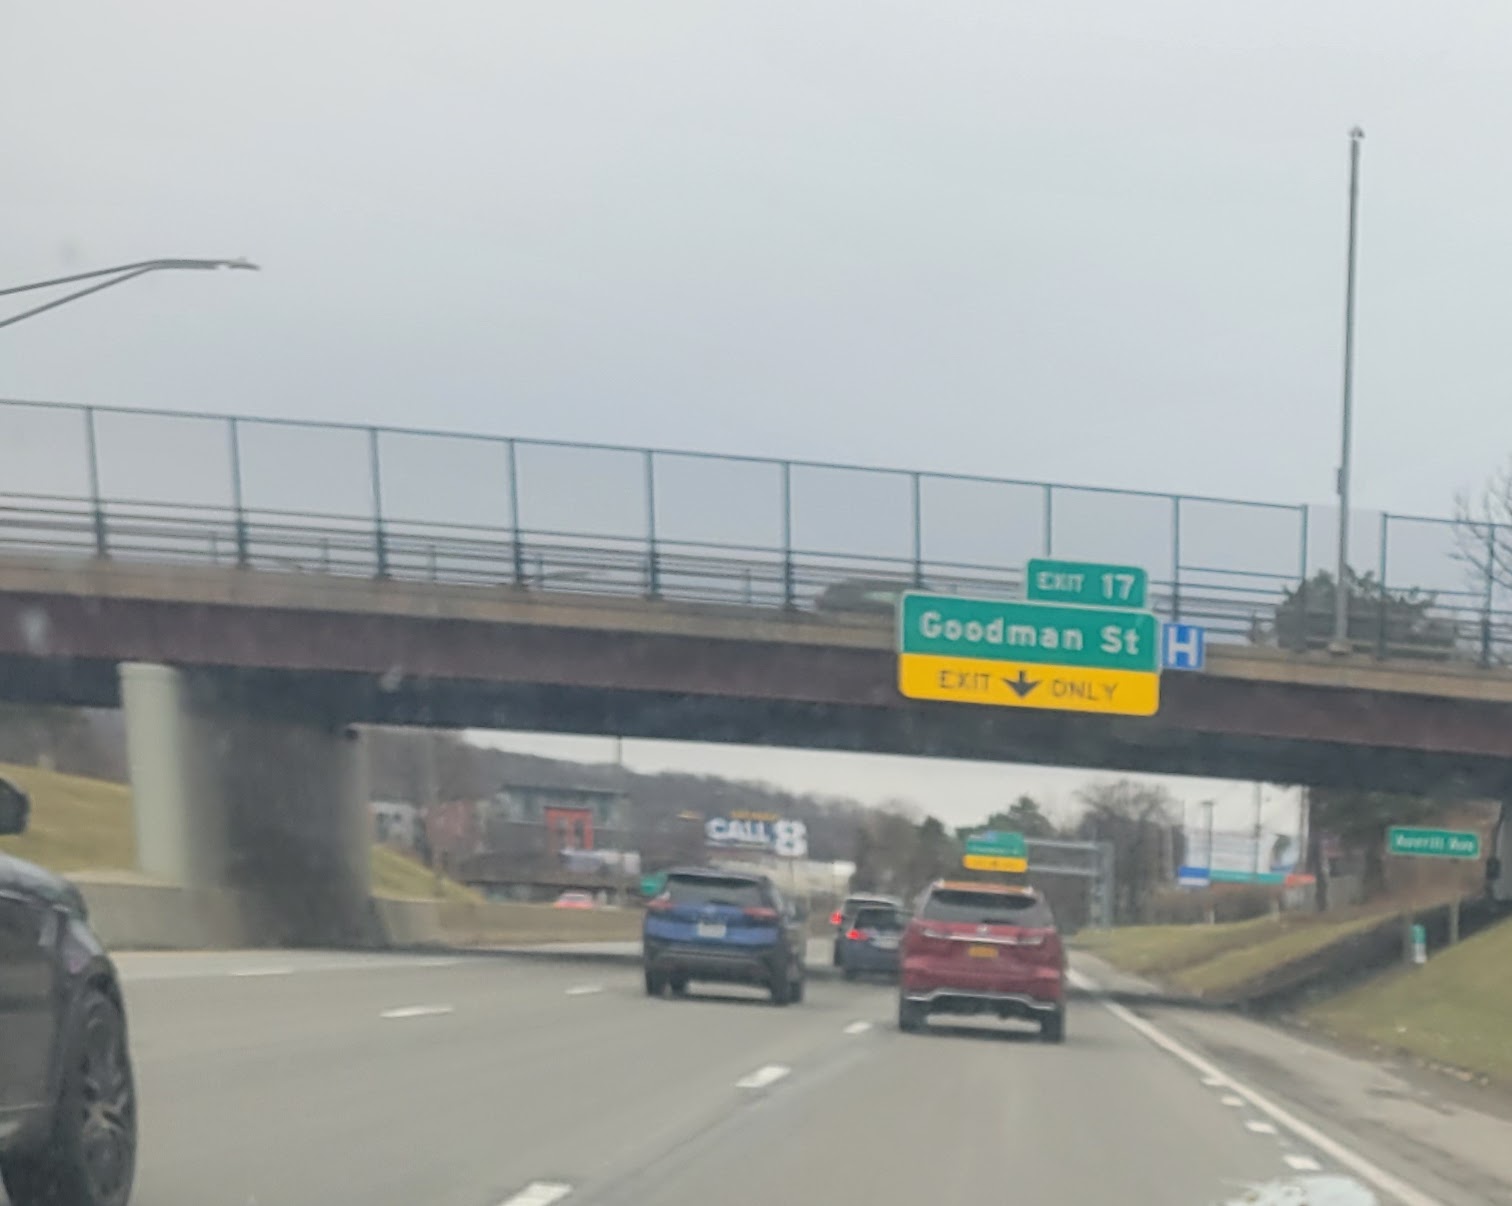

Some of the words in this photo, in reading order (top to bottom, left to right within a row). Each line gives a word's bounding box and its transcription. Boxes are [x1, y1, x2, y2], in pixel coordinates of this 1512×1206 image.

[1036, 570, 1085, 593] EXIT
[1102, 573, 1135, 600] 17
[919, 611, 1083, 651] Goodman
[1101, 625, 1140, 655] St
[1167, 626, 1197, 667] H
[939, 670, 991, 692] EXIT
[1051, 679, 1118, 702] ONLY
[704, 817, 771, 841] CALL
